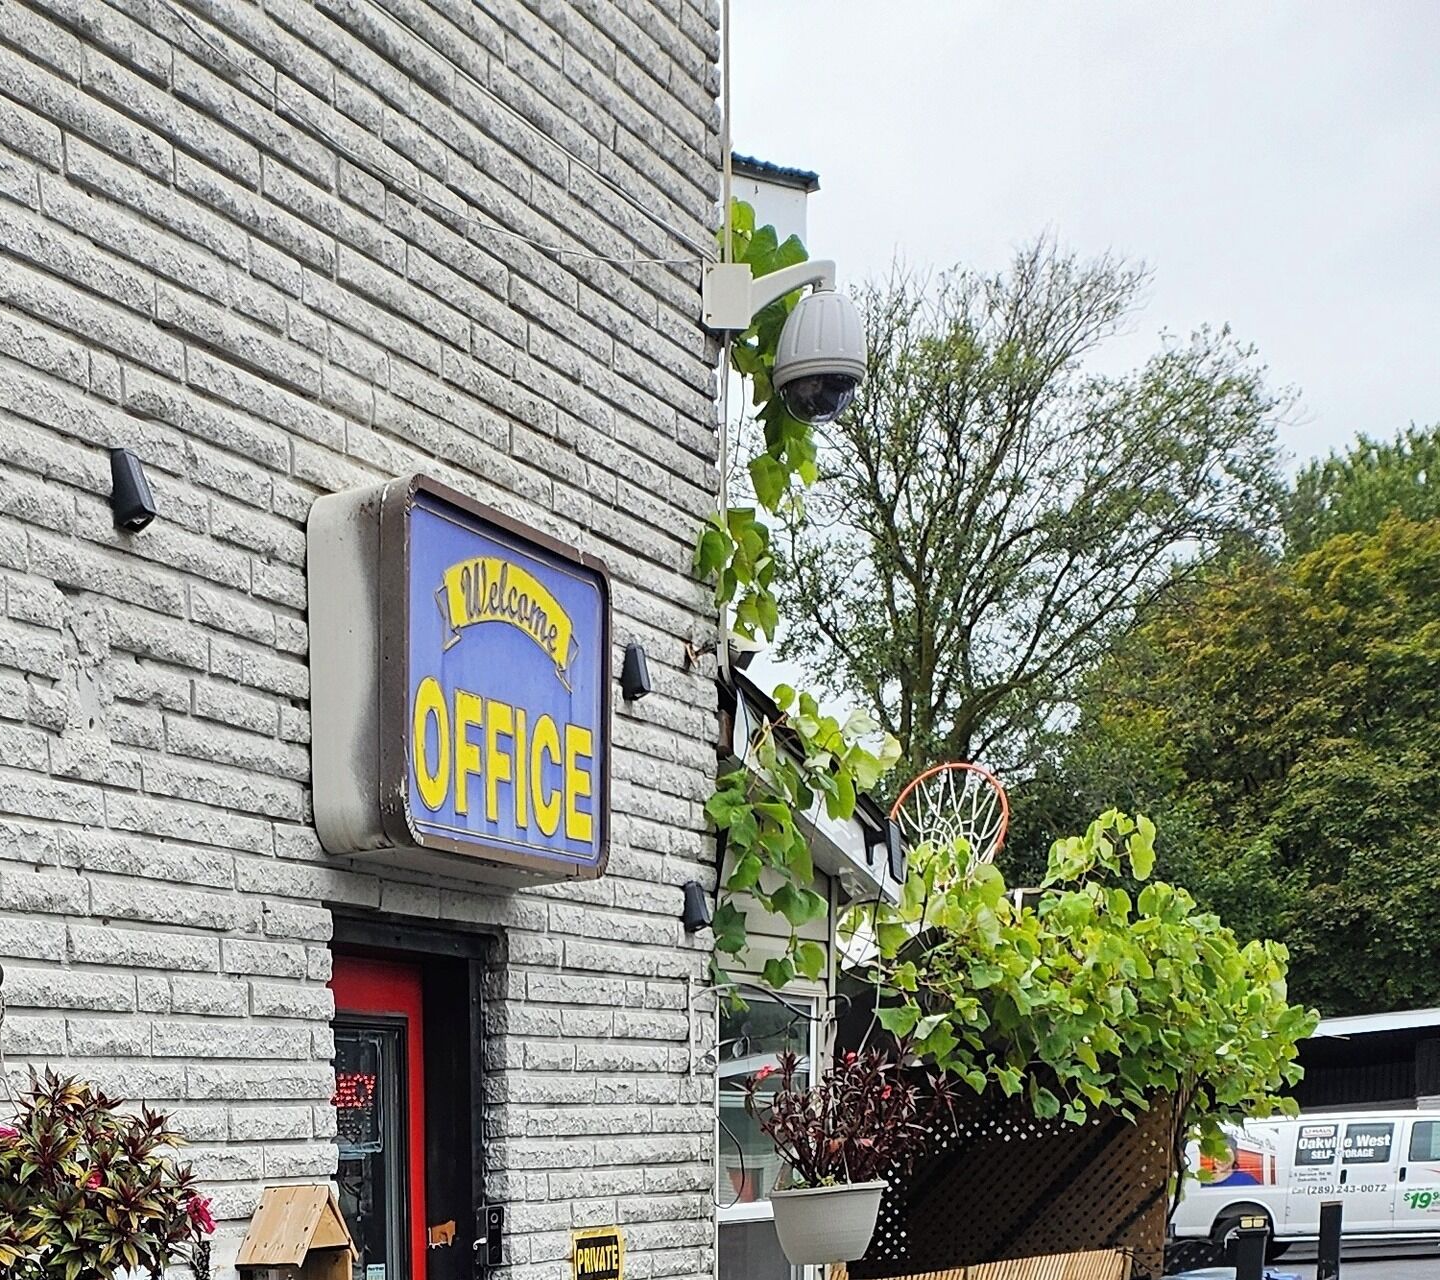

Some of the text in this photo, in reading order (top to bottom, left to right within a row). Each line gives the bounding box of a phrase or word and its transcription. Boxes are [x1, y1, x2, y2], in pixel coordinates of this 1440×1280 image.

[459, 561, 559, 653] Welcome
[412, 675, 593, 843] OFFICE
[1356, 1133, 1391, 1147] West
[1307, 1184, 1335, 1196] (289)
[1336, 1183, 1387, 1194] 243-0072
[577, 1244, 619, 1275] PRIVATE
